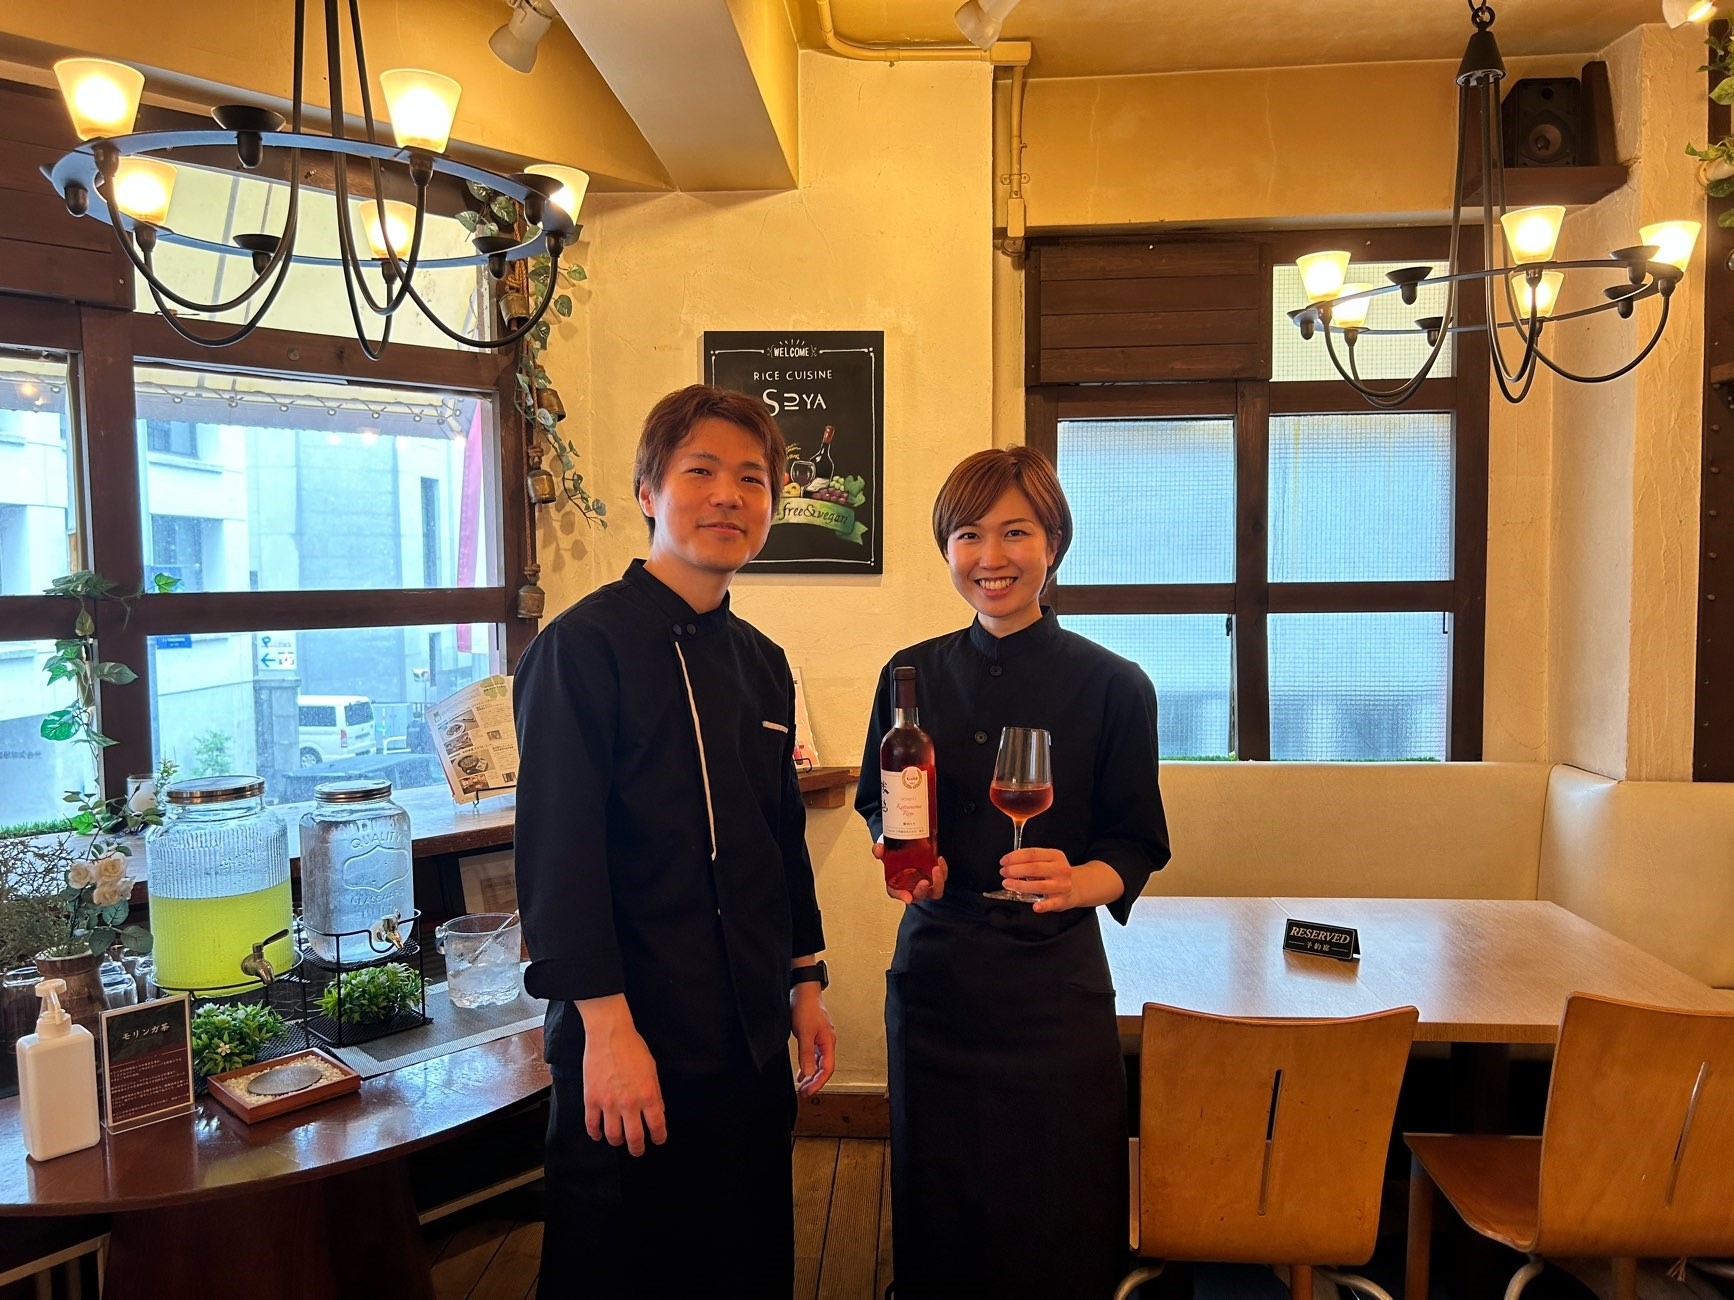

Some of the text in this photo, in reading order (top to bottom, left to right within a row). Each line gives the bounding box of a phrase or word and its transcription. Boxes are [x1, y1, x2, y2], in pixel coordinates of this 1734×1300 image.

[774, 347, 810, 357] WELCOME
[753, 370, 833, 381] RICE CUISINE
[351, 831, 403, 848] QUALITY
[1289, 926, 1351, 944] RESERVED
[121, 1022, 171, 1040] モリンガ茶
